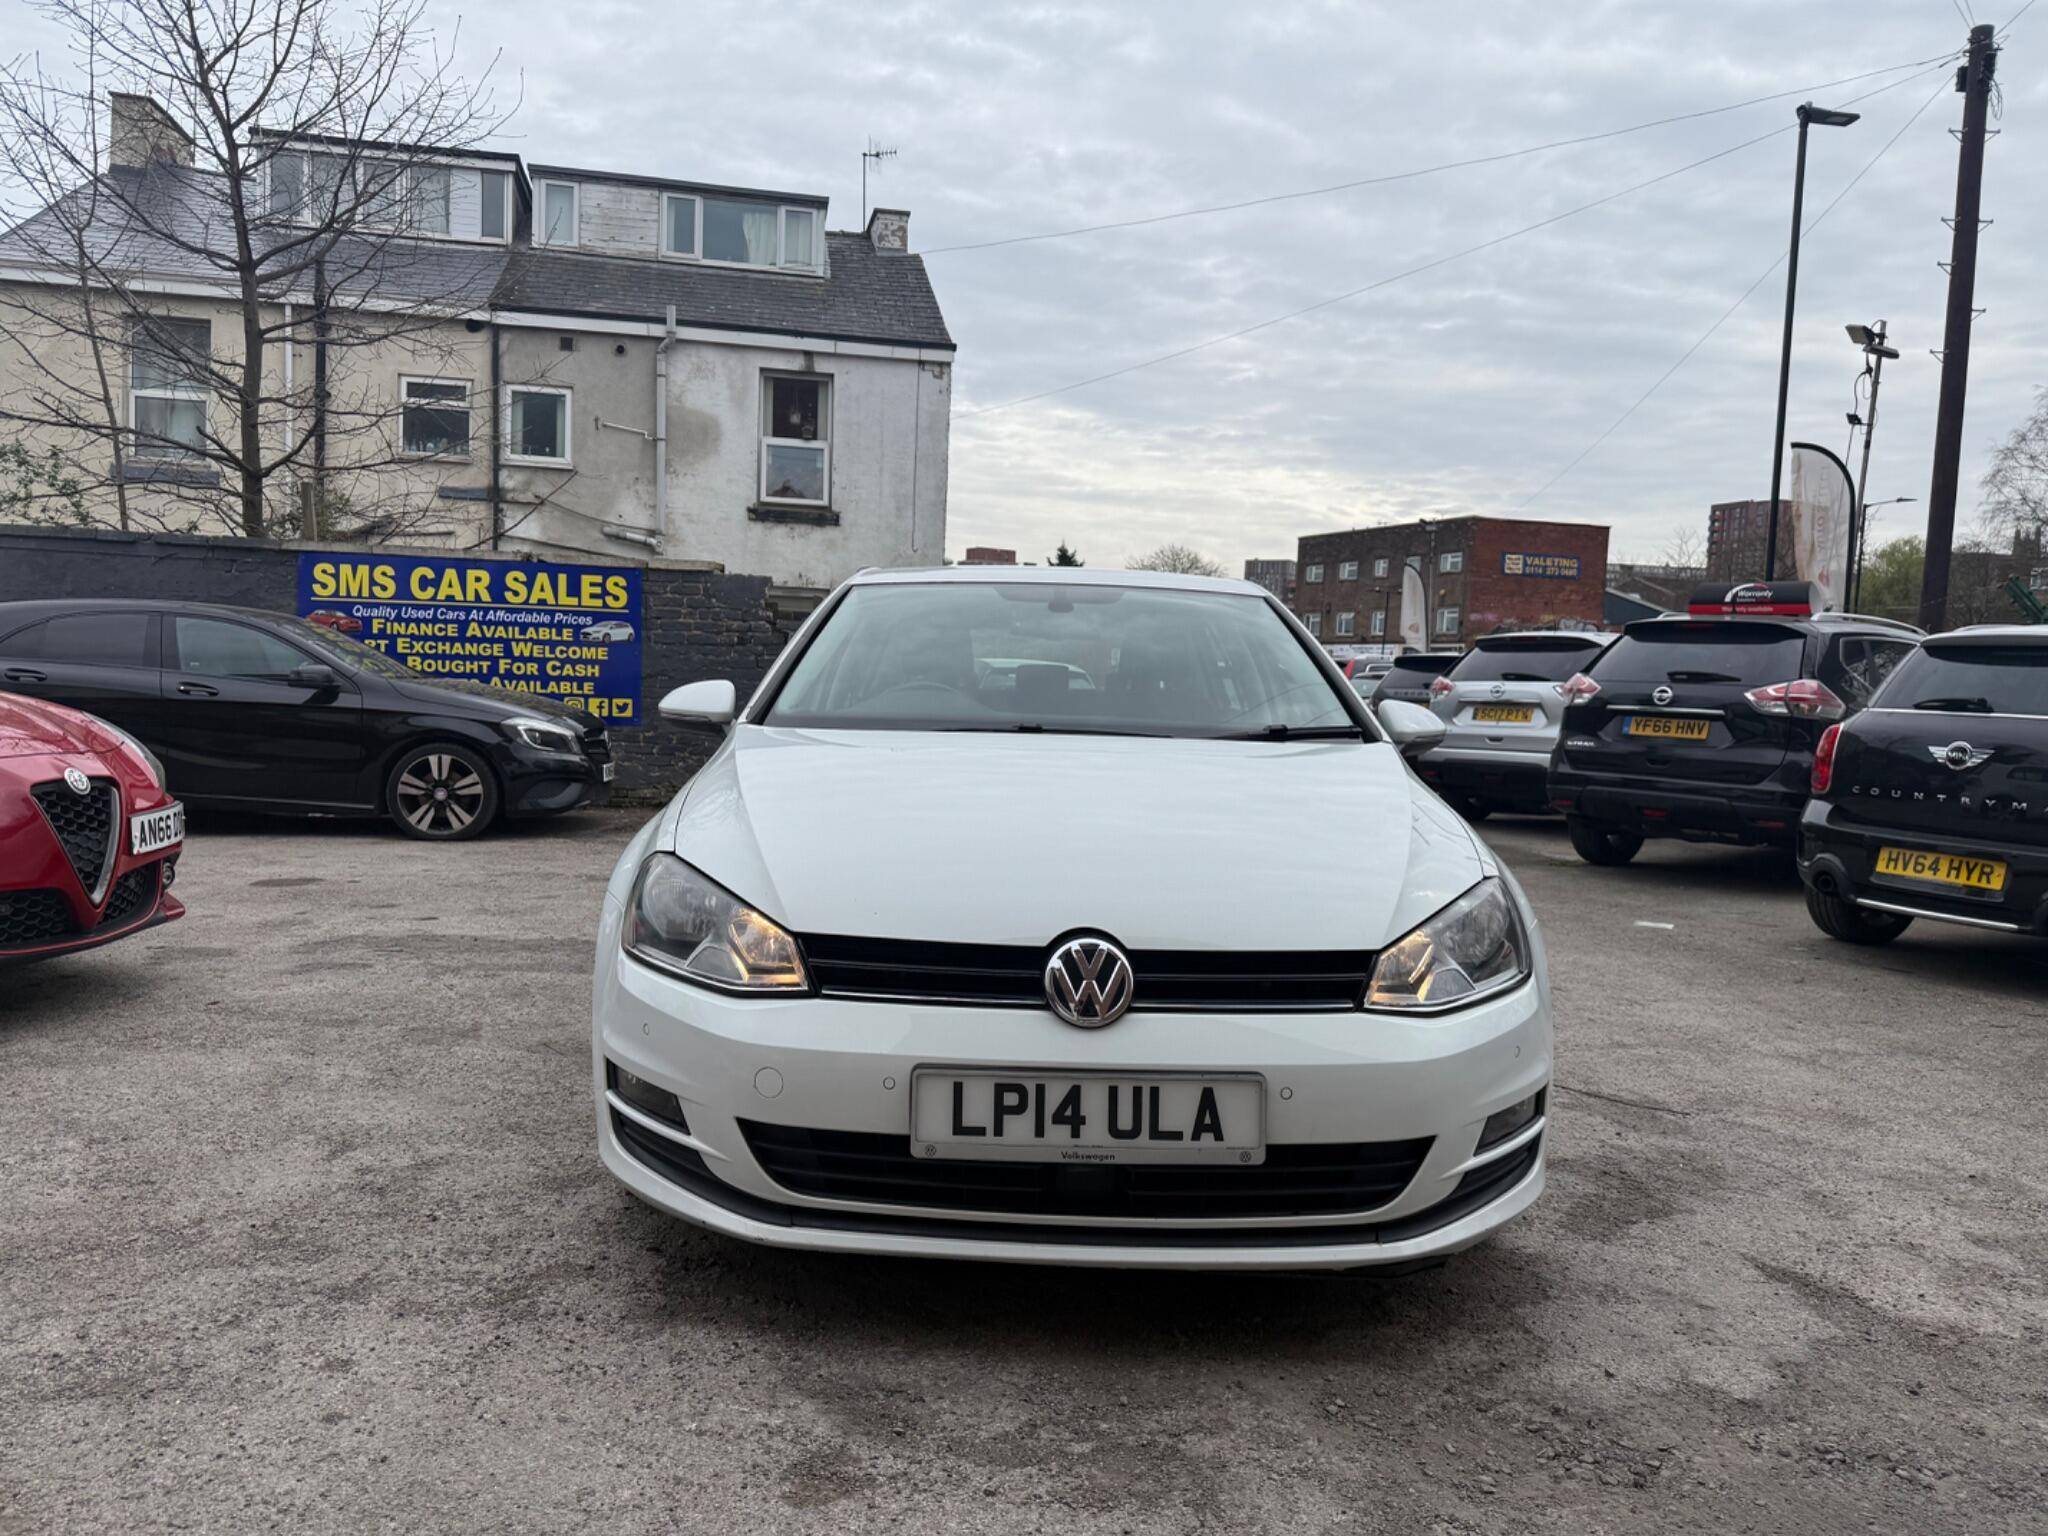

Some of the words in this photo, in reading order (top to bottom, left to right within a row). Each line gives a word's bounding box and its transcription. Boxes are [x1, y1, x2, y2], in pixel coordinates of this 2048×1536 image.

[1525, 556, 1577, 567] VALETING
[312, 562, 397, 599] SMS
[410, 566, 492, 602] CAR
[504, 570, 629, 609] SALES
[352, 604, 398, 620] Quality
[401, 607, 434, 620] Used
[437, 608, 466, 620] Cars
[468, 609, 484, 621] At
[486, 610, 551, 624] Affordable
[554, 612, 593, 626] Prices
[372, 618, 459, 637] FINANCE
[466, 622, 574, 641] AVAILABLE
[397, 638, 505, 657] EXCHANGE
[511, 641, 609, 660] WELCOME
[407, 656, 491, 674] BOUGHT
[498, 659, 539, 675] FOR
[546, 660, 600, 677] CASH
[489, 676, 595, 695] AVAILABLE
[1633, 718, 1672, 734] YF66
[1675, 720, 1707, 736] HNV
[139, 814, 172, 848] AN66
[1885, 851, 1941, 876] HV64
[1946, 858, 1995, 885] HYR
[952, 1081, 1086, 1139] LP14
[1107, 1085, 1224, 1142] ULA
[1060, 1151, 1116, 1162] Volkswagen
